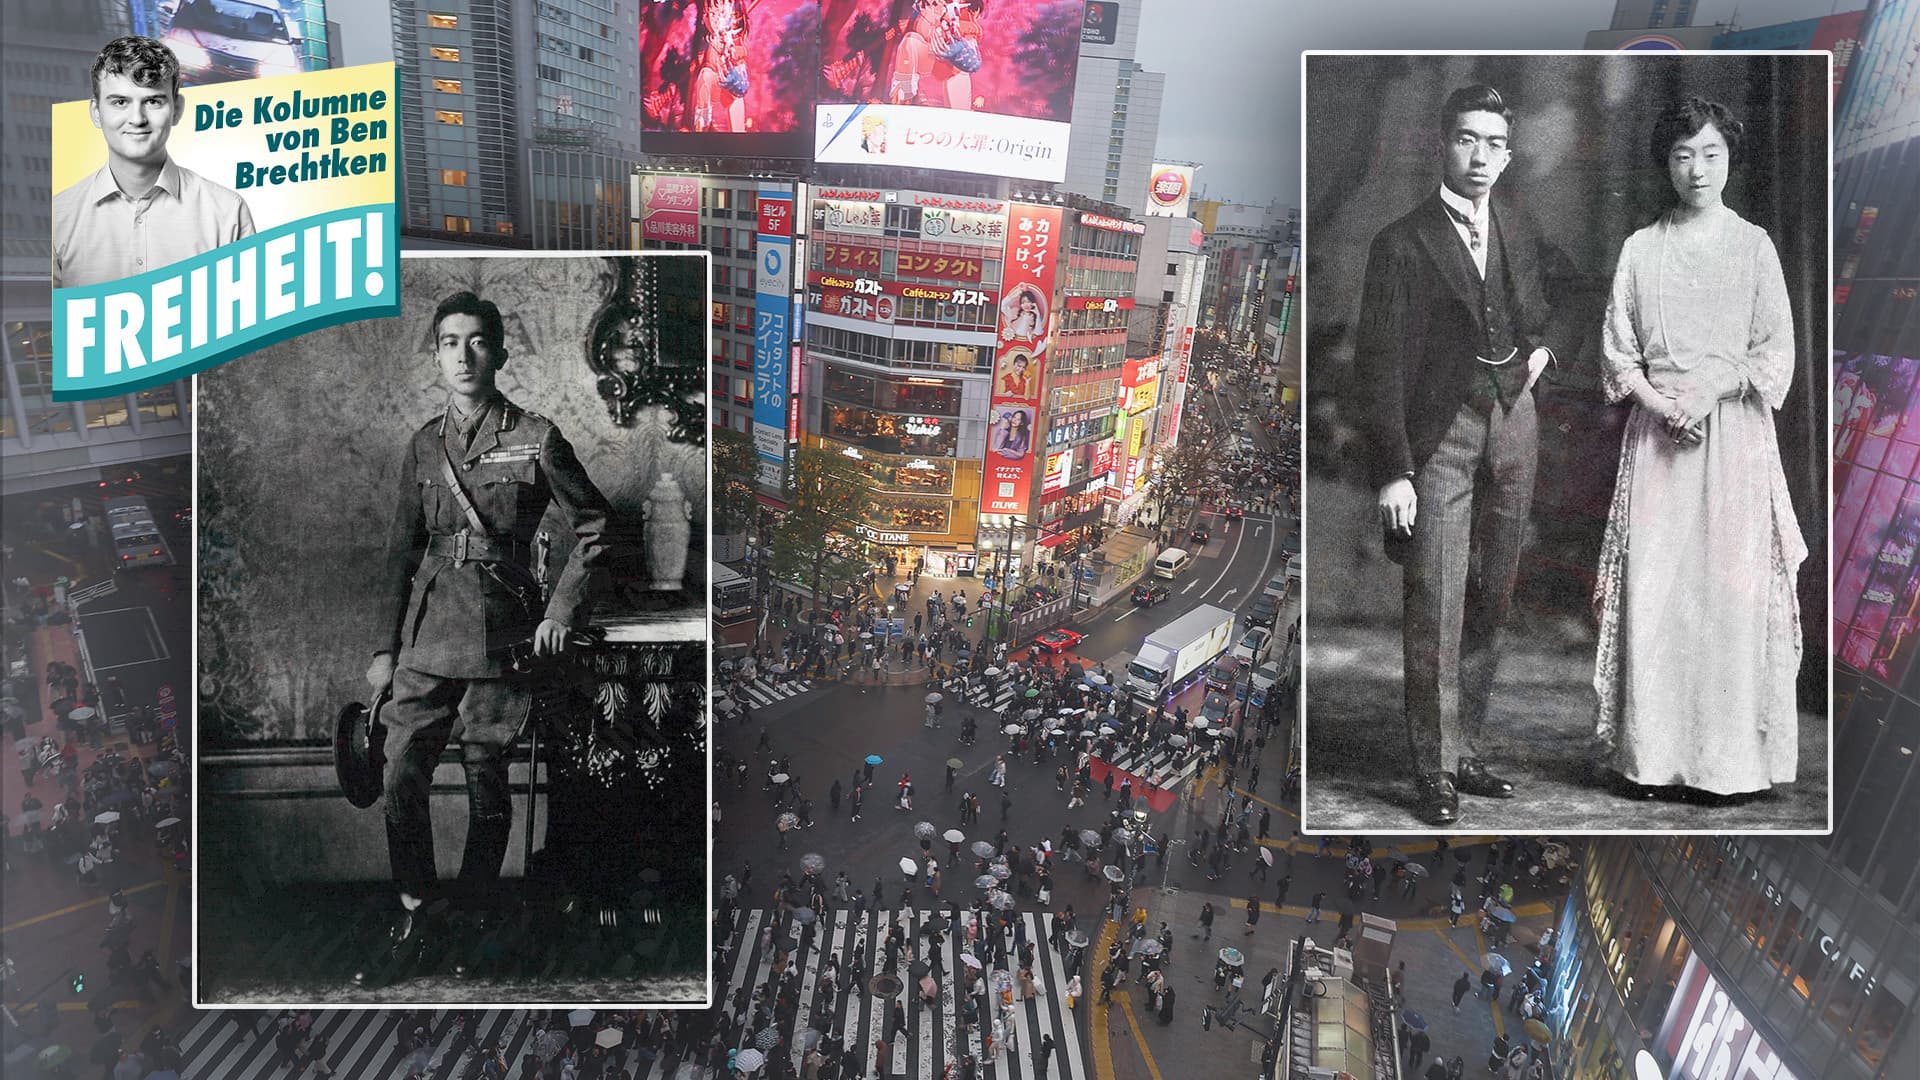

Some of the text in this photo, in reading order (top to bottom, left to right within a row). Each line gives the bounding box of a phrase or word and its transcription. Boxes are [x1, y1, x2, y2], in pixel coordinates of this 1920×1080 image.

[763, 203, 787, 217] 当ビル
[814, 209, 825, 221] 9F
[768, 218, 781, 231] 5F
[950, 216, 1002, 238] しゃぶ葉
[1015, 217, 1034, 270] みっけ。
[1031, 218, 1050, 278] カワイイ
[825, 246, 881, 267] プライス
[898, 254, 979, 277] コンタクト
[854, 278, 883, 296] ガスト
[810, 293, 823, 305] 7F
[840, 295, 874, 317] ガスト
[951, 289, 990, 307] ガスト
[757, 311, 773, 405] アイシティ
[771, 314, 785, 408] コンタクトの
